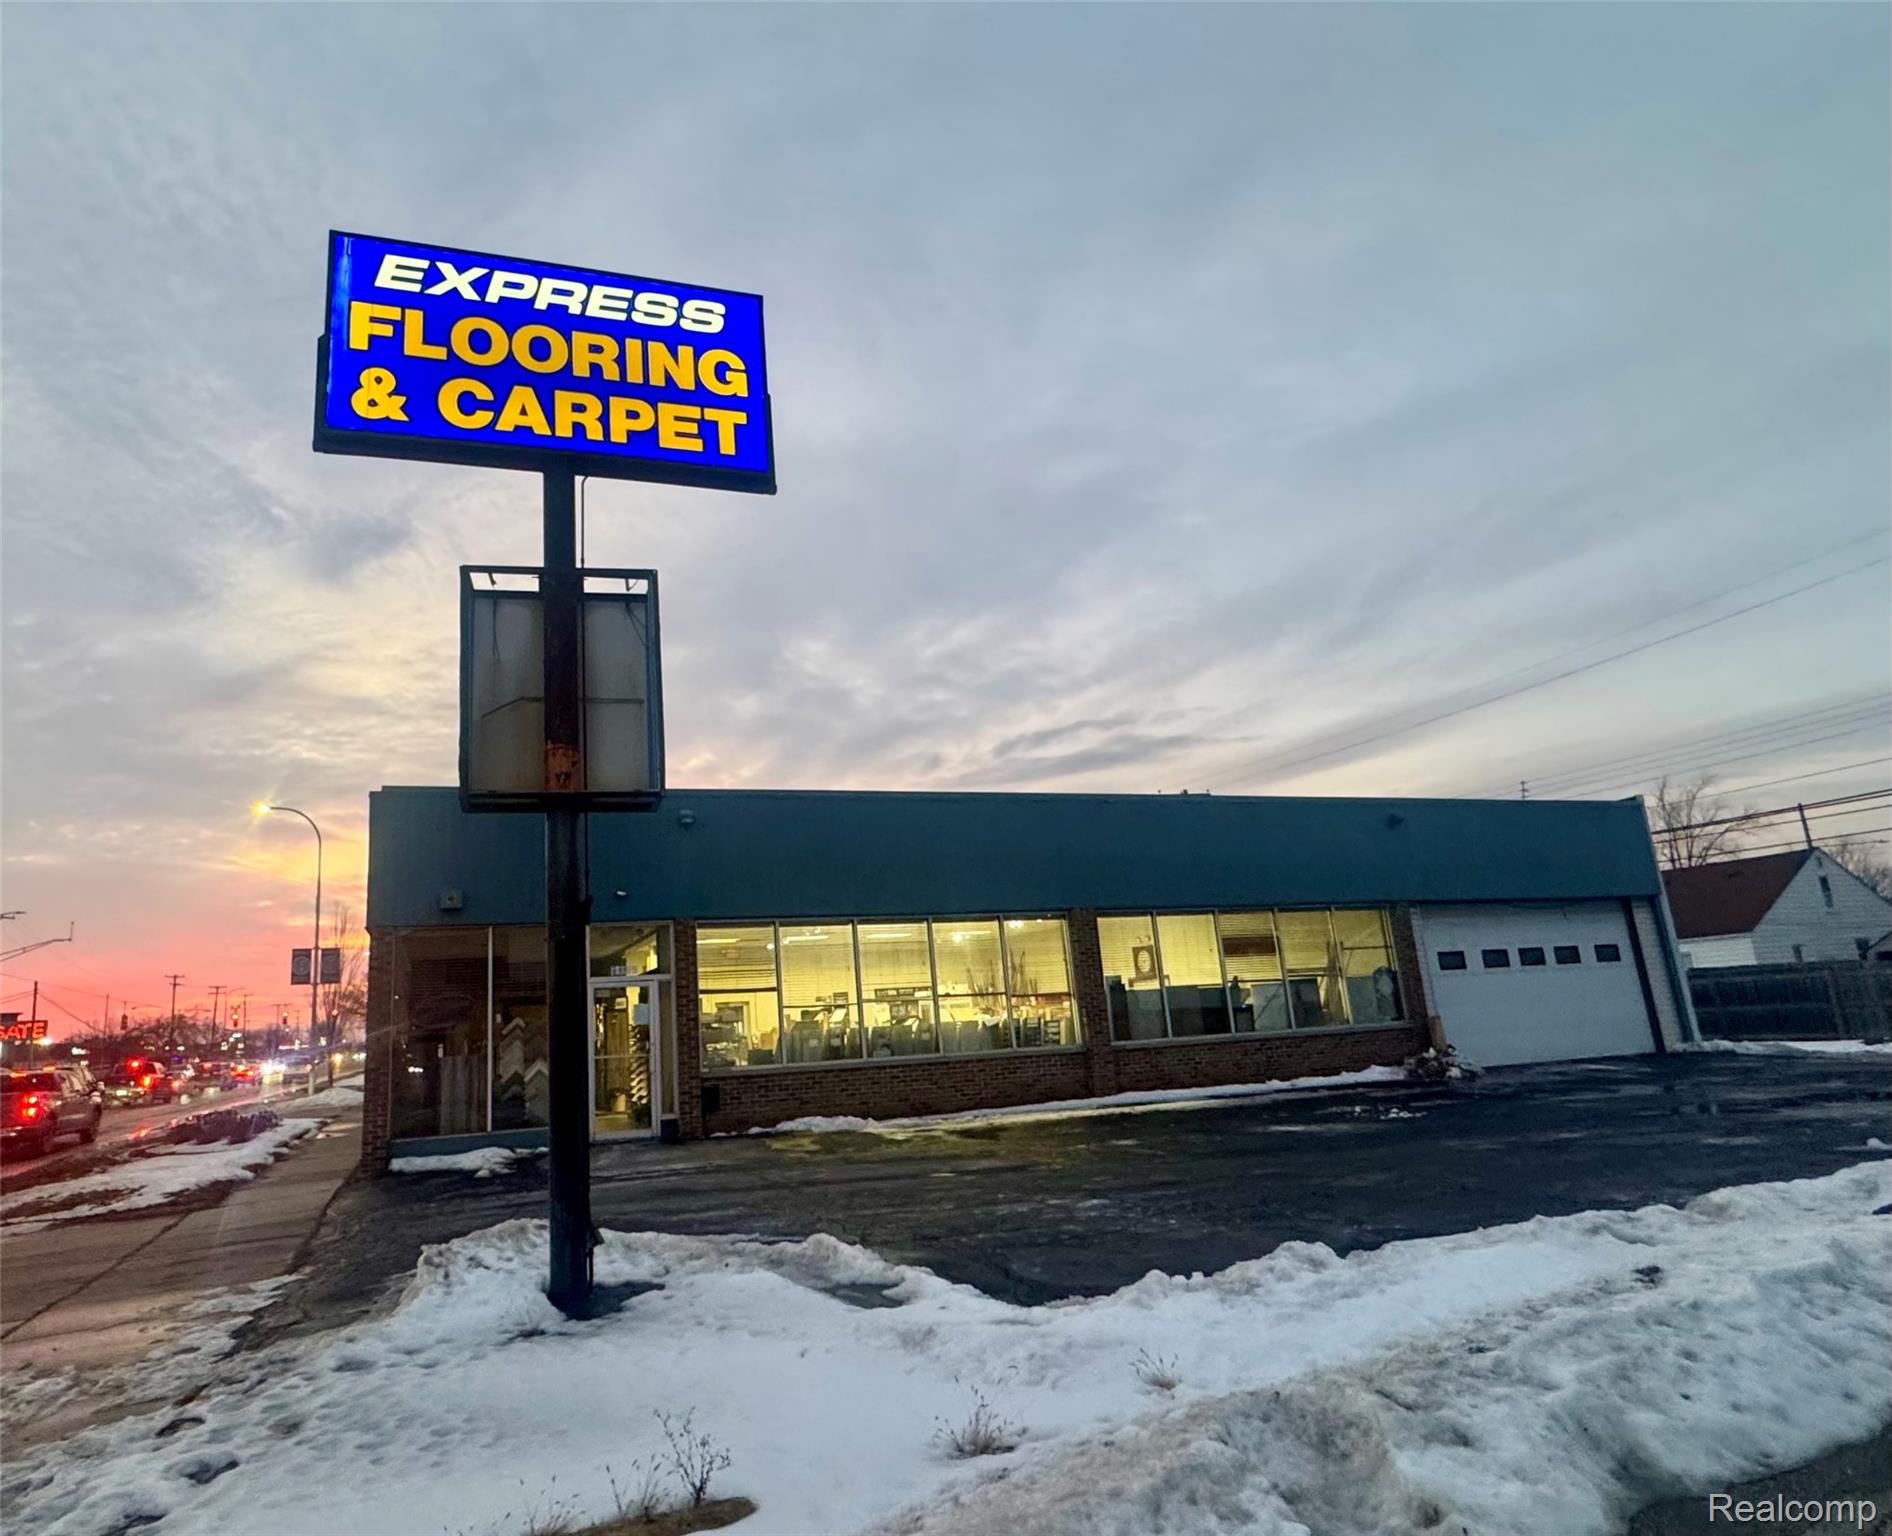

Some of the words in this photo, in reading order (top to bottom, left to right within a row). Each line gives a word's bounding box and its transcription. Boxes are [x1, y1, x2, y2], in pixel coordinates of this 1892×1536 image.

[374, 253, 726, 334] EXPRESS
[349, 300, 749, 398] FLOORING
[350, 366, 409, 422] &
[437, 377, 748, 456] CARPET
